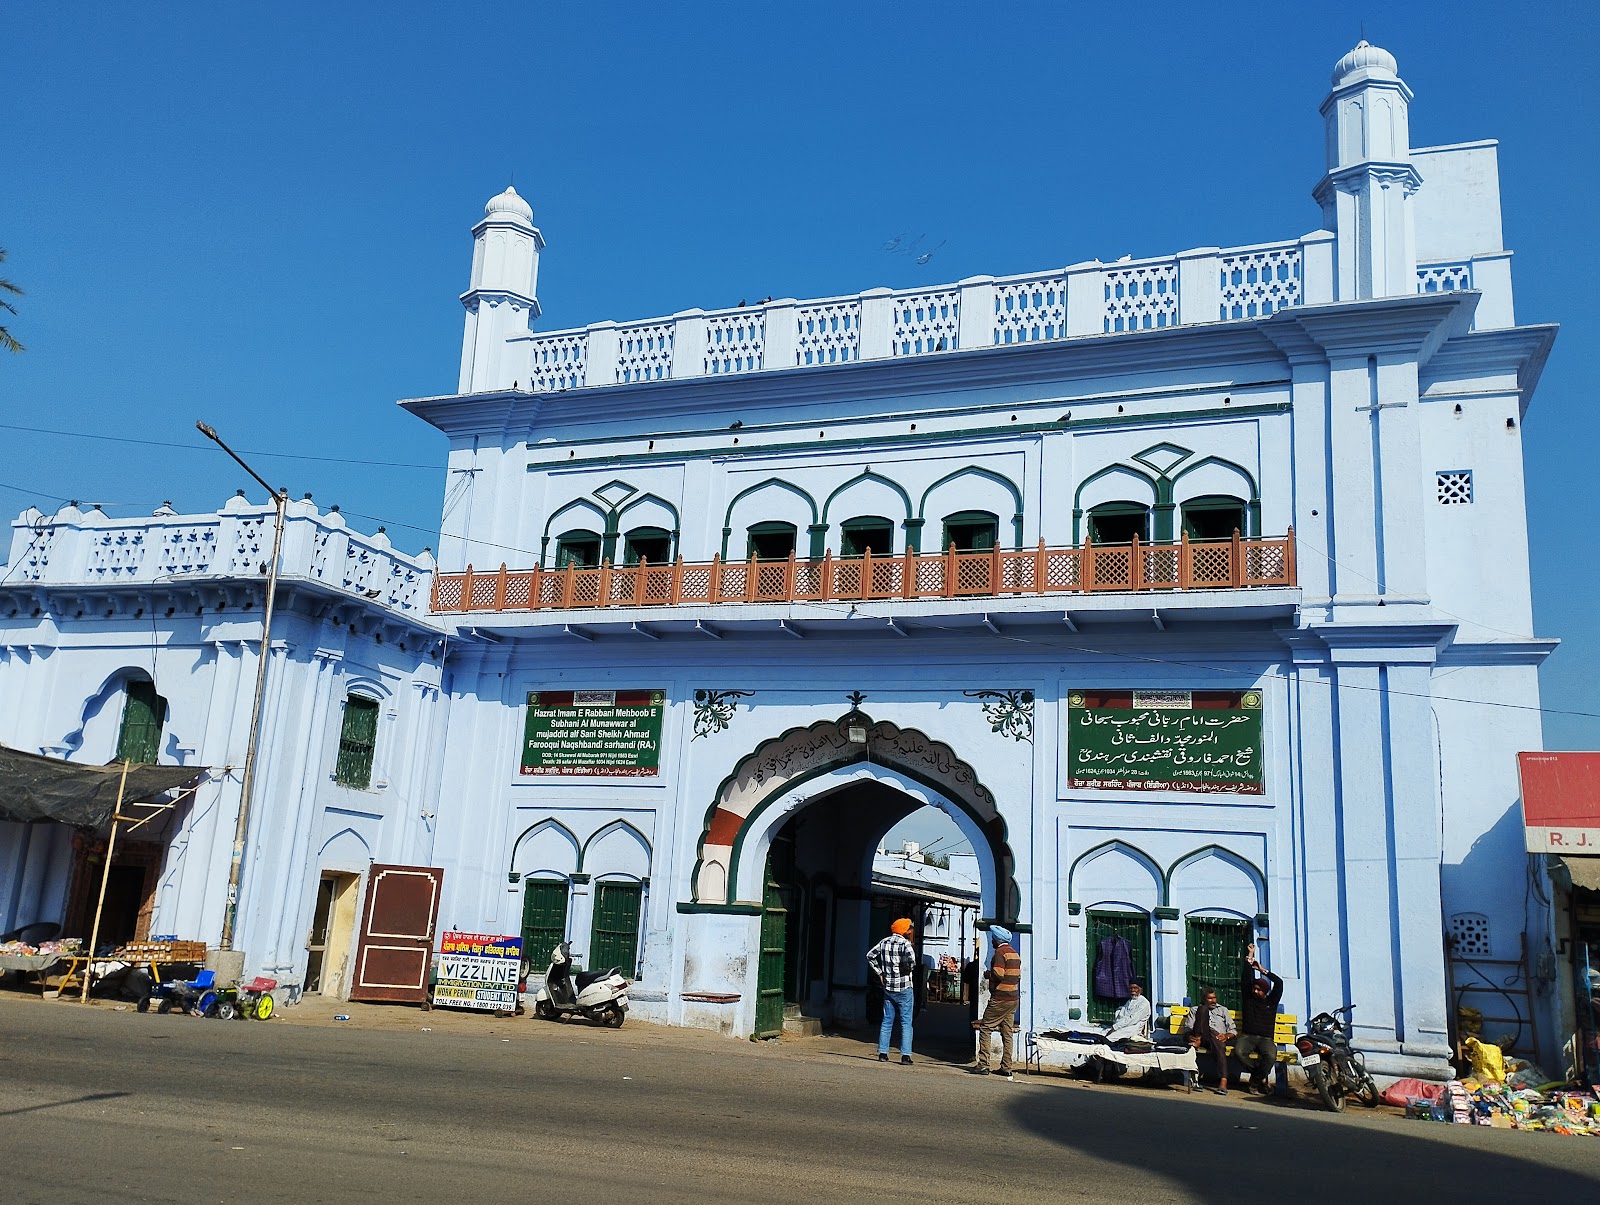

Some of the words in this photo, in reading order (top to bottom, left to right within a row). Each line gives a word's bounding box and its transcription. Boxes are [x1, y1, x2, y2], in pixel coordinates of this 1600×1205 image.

[534, 709, 556, 717] Hazrat
[557, 709, 576, 717] Imam
[578, 709, 583, 717] E
[585, 709, 614, 717] Rabbani
[615, 709, 649, 717] Mehboob
[651, 709, 656, 717] E
[551, 720, 579, 728] Subhani
[1205, 715, 1250, 729] حضرت
[536, 730, 568, 739] mujaddid
[569, 730, 580, 738] alf
[580, 730, 596, 738] Sani
[597, 730, 622, 738] Sheikh
[624, 730, 650, 738] Ahmad
[529, 740, 560, 750] Farooqui
[561, 740, 602, 750] Naqshbandi
[604, 741, 636, 749] sarhandi
[637, 741, 656, 750] (RA.)
[1212, 754, 1234, 763] احمد
[1235, 746, 1254, 765] شیخ
[1550, 832, 1569, 846] R.
[1577, 833, 1592, 846] J.
[441, 962, 517, 983] VIZZLINE
[438, 979, 484, 988] IMMIGRATION
[437, 987, 452, 996] WORK
[454, 988, 474, 998] PERMIT
[477, 990, 501, 1001] STUDENT
[501, 992, 514, 1002] VISA
